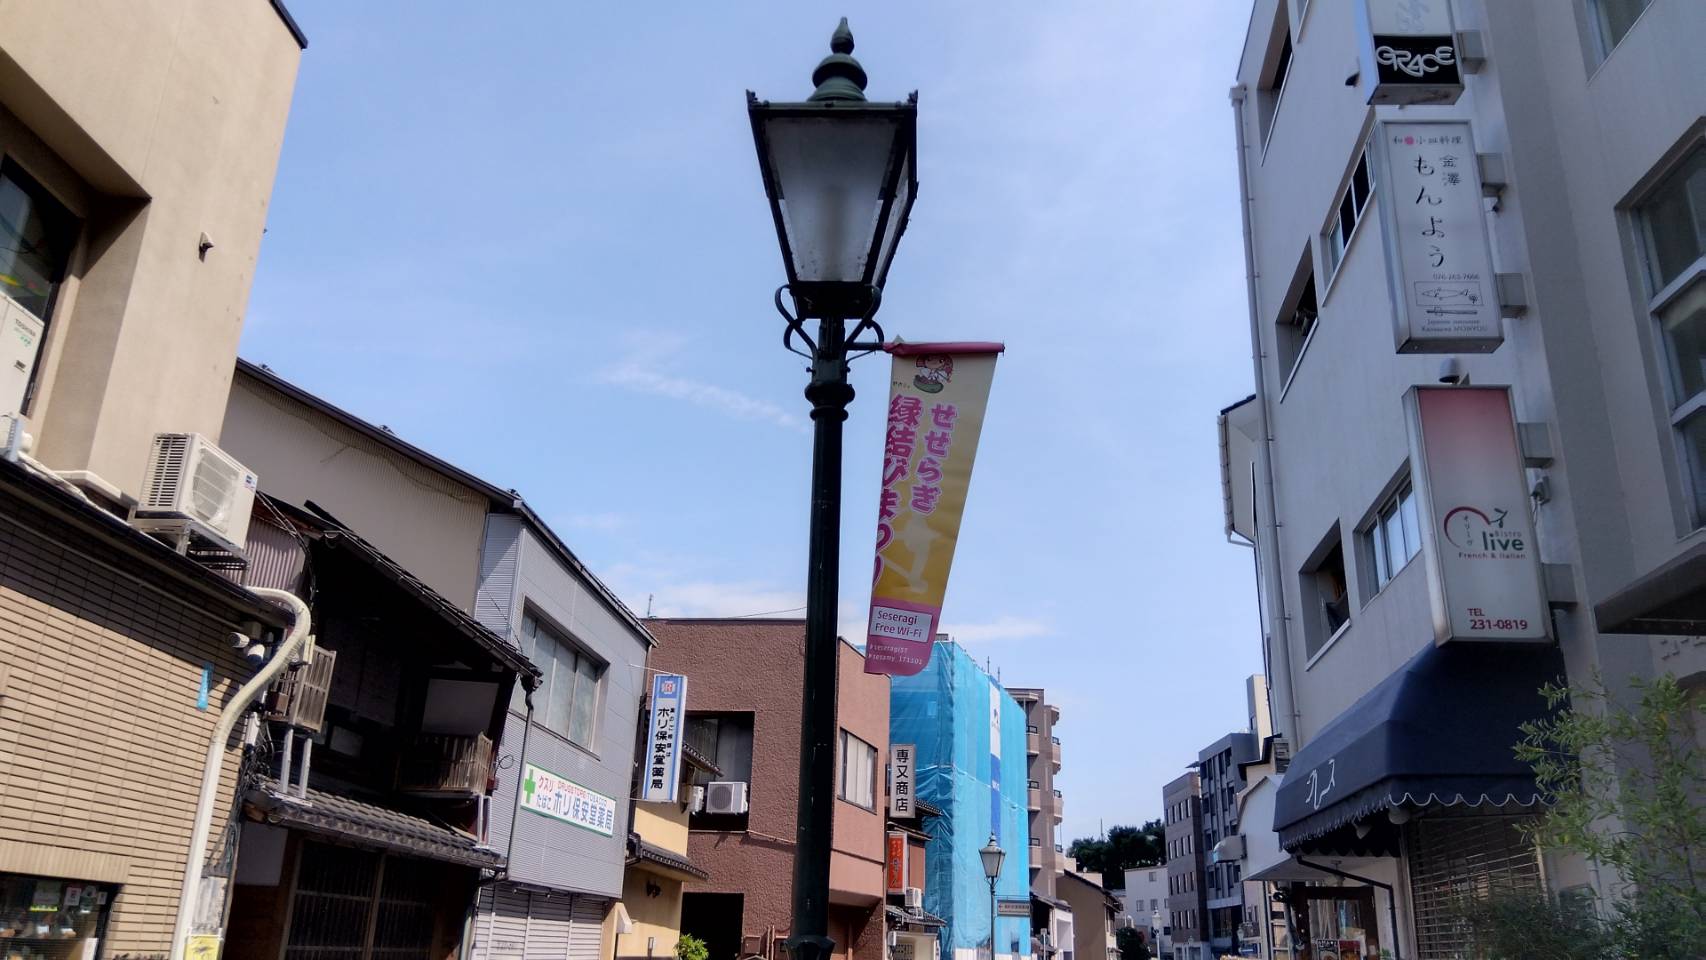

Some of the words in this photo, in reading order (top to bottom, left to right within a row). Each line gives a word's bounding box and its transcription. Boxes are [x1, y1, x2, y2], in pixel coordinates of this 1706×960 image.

[1376, 46, 1455, 77] GRACE
[1414, 155, 1445, 267] もんよう
[911, 403, 957, 513] せせらぎ
[1482, 531, 1524, 551] live
[877, 610, 918, 625] Seseragi
[1467, 608, 1485, 617] TEL
[1470, 619, 1528, 630] 231-0819
[875, 623, 895, 633] Free
[898, 626, 922, 637] Wi-Fi
[650, 708, 670, 789] ホリ保安堂薬局
[539, 776, 553, 792] クスリ
[896, 749, 909, 811] 専又商店
[553, 791, 612, 830] ホリ保安堂薬局
